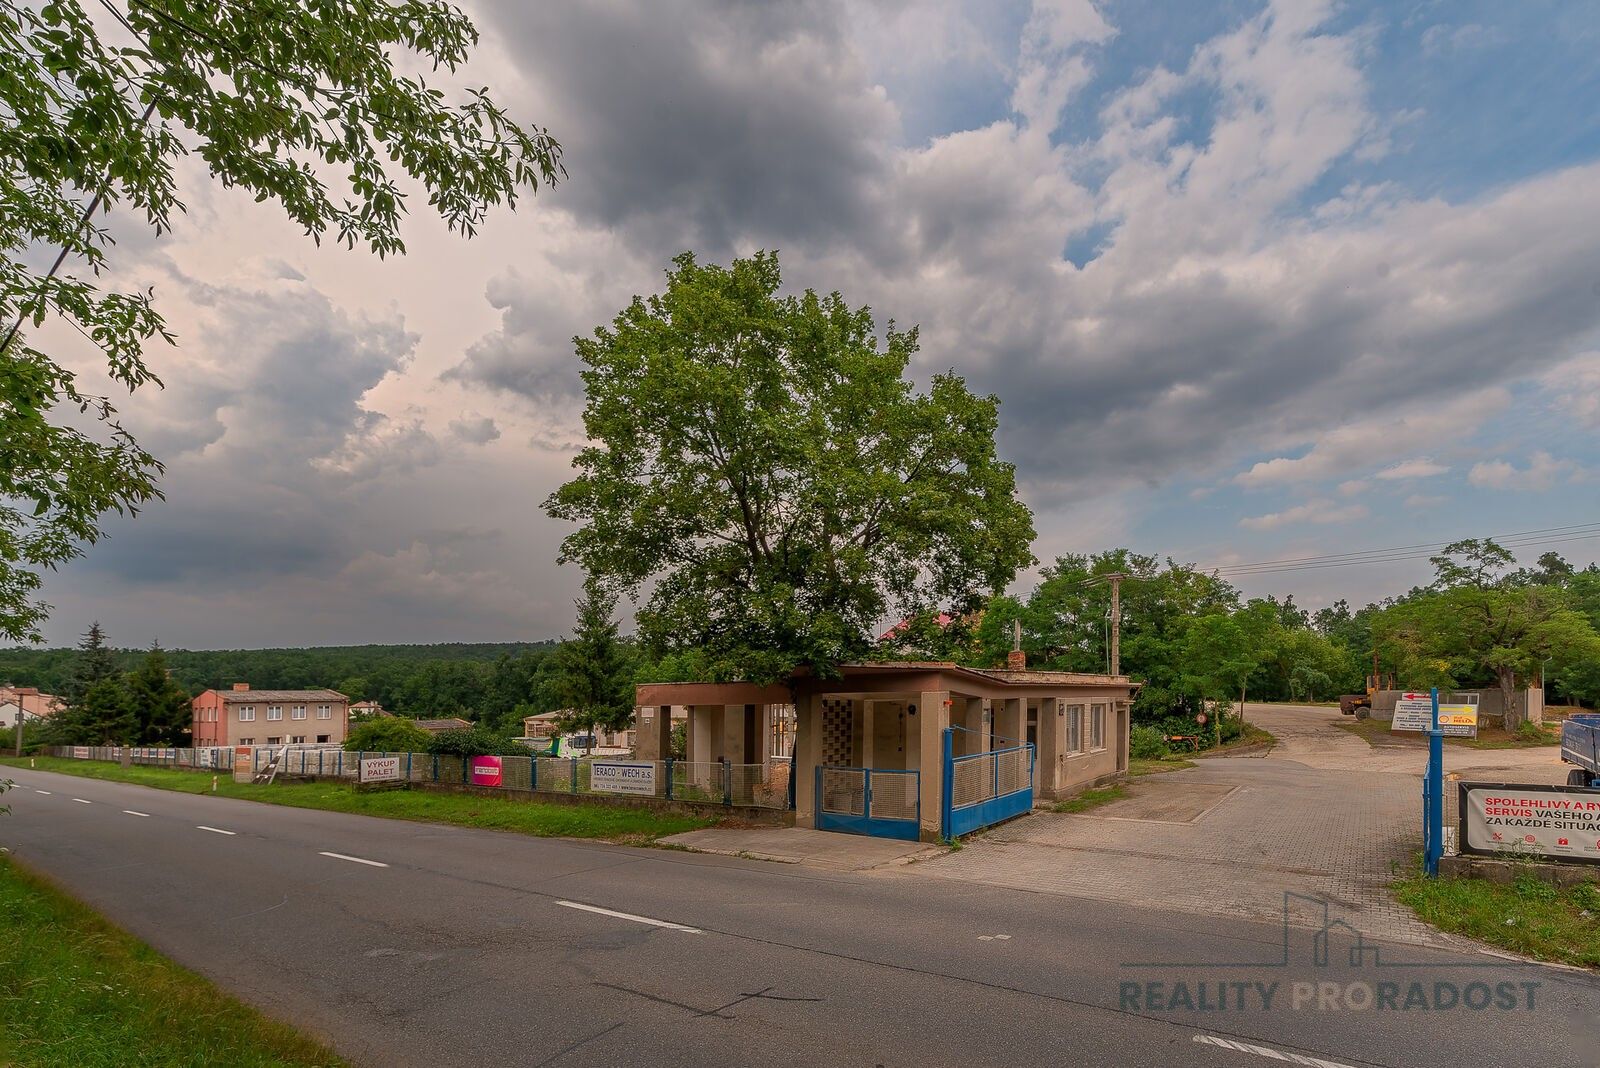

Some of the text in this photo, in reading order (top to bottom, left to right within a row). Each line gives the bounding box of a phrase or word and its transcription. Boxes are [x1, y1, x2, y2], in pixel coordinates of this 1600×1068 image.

[366, 760, 395, 768] VÝKUP
[367, 768, 394, 777] PALET
[594, 765, 616, 777] TERACO
[622, 768, 640, 778] WECH
[641, 770, 653, 779] a.s.
[1485, 797, 1571, 810] SPOLEHLIVÝ
[1573, 801, 1583, 811] A
[1485, 807, 1533, 818] SERVIS
[1535, 810, 1593, 821] VAŠEHO
[1485, 817, 1503, 826] ZA
[1505, 818, 1552, 829] KAŽDÉ
